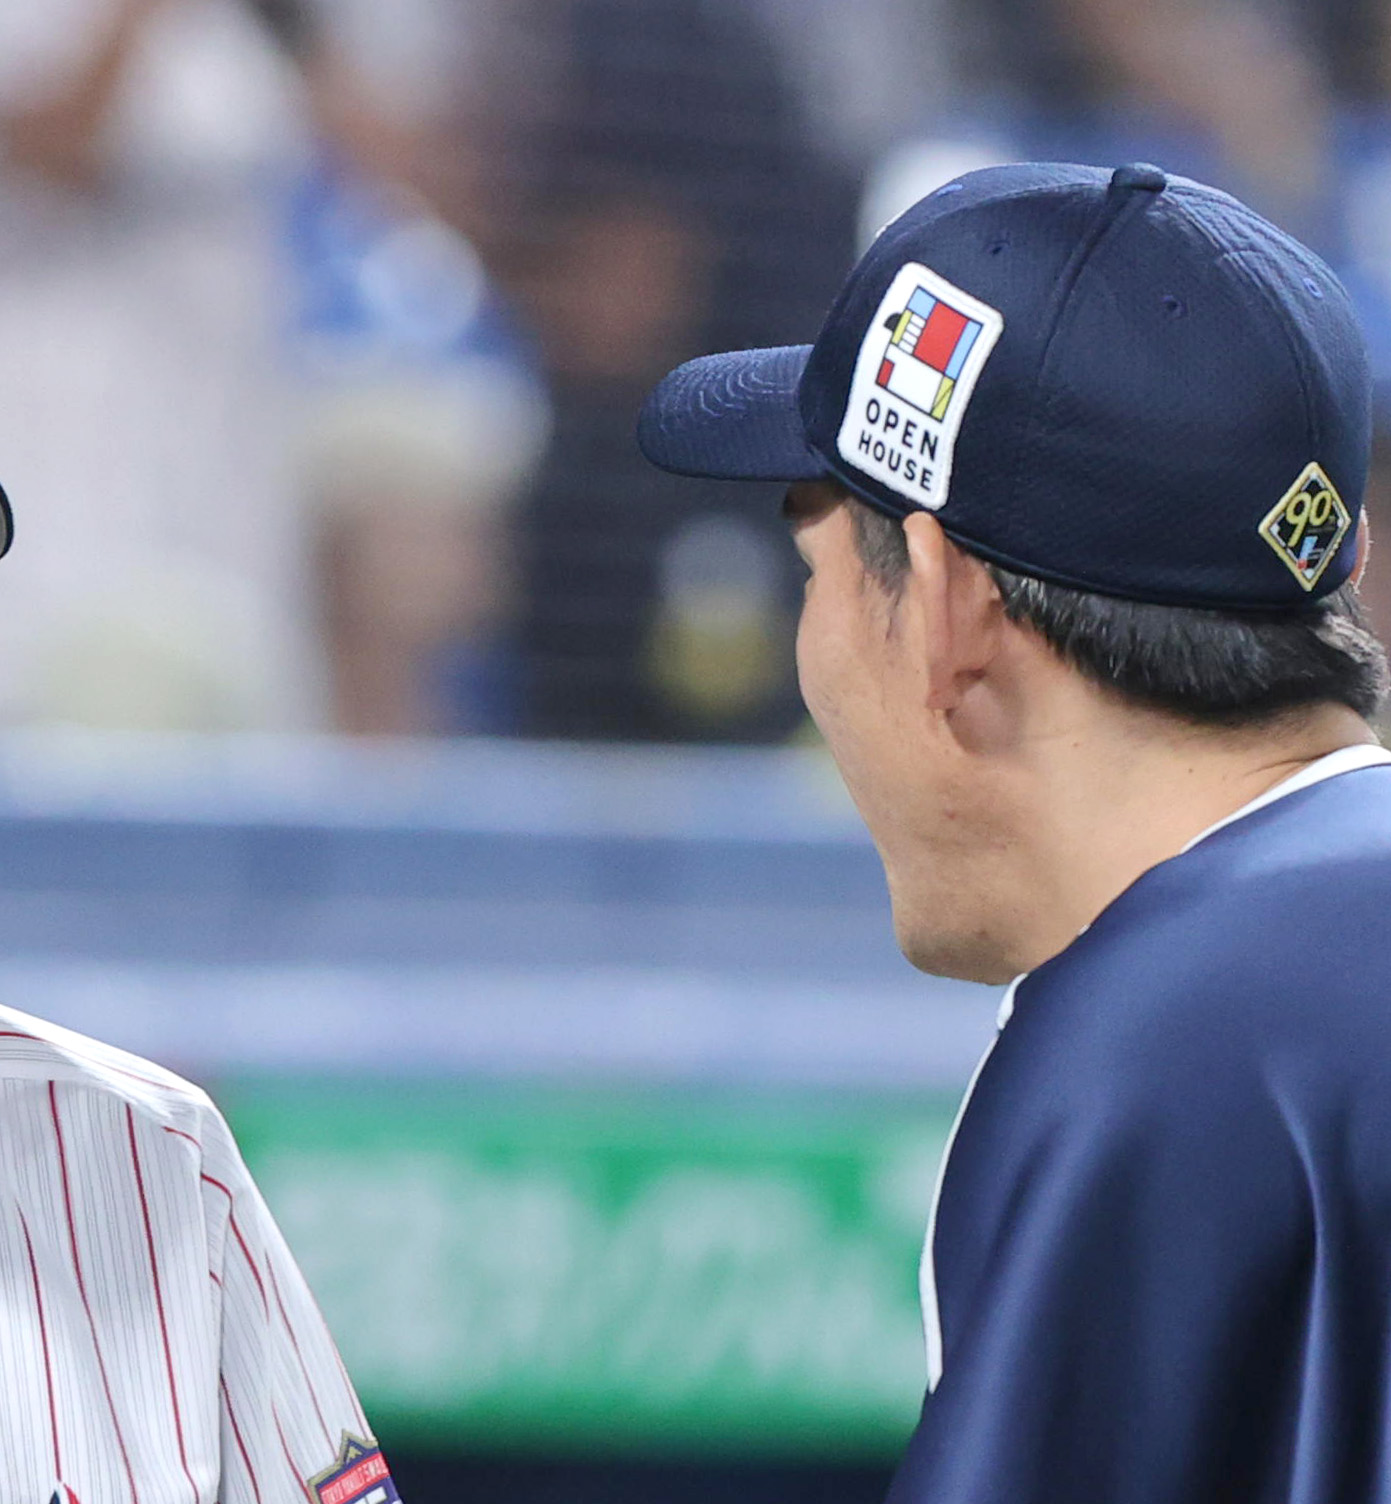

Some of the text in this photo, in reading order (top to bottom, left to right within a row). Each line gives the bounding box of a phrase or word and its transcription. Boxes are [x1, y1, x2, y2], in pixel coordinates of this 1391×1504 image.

[858, 430, 934, 492] HOUSE
[866, 399, 939, 462] OPEN
[1286, 489, 1332, 548] 90
